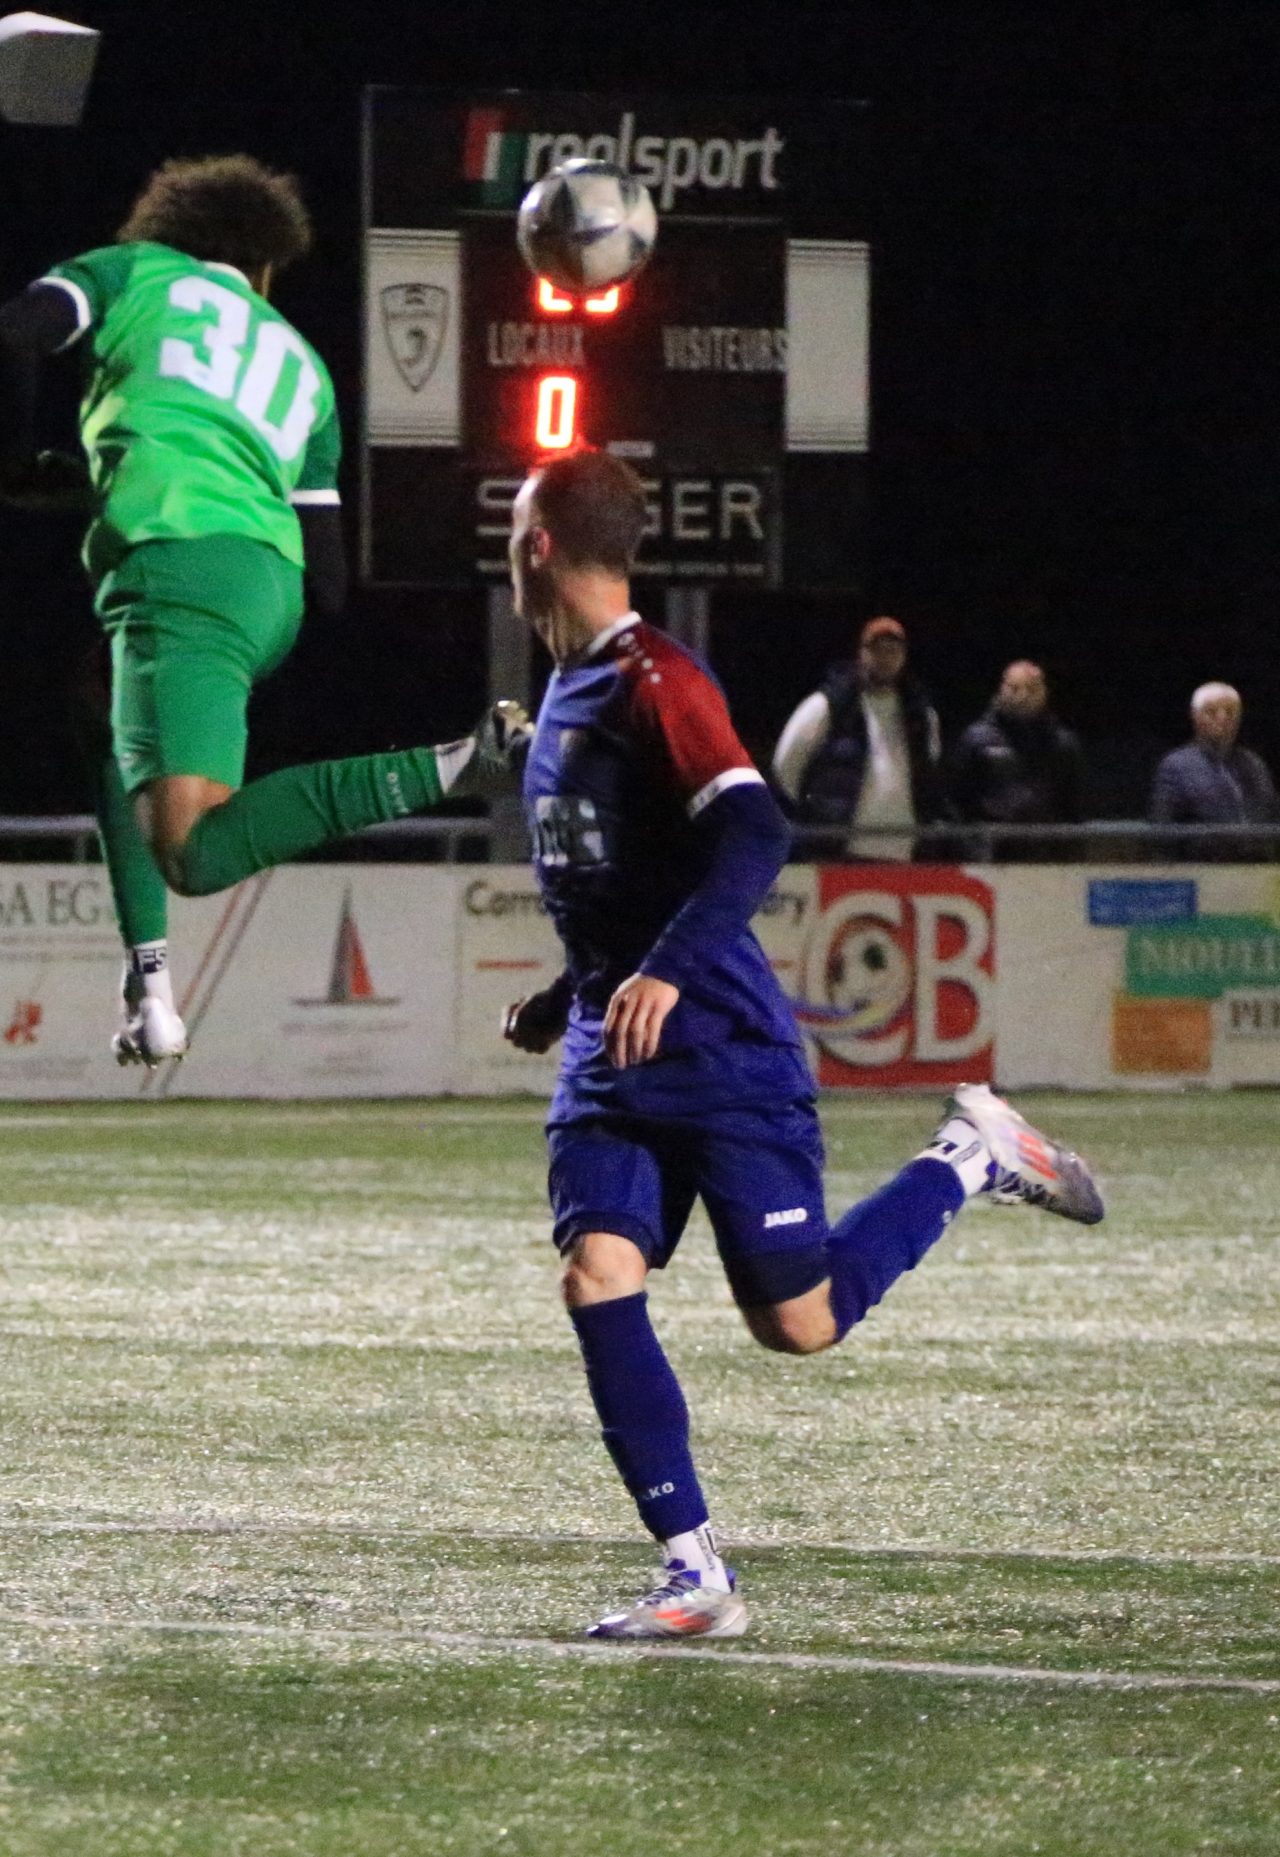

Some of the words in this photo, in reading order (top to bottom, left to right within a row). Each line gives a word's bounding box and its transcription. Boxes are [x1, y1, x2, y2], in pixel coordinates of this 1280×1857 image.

[487, 321, 587, 367] LOCAUX
[159, 274, 321, 463] 30
[535, 375, 578, 450] 0
[46, 879, 122, 927] EG
[764, 1207, 808, 1229] JAKO
